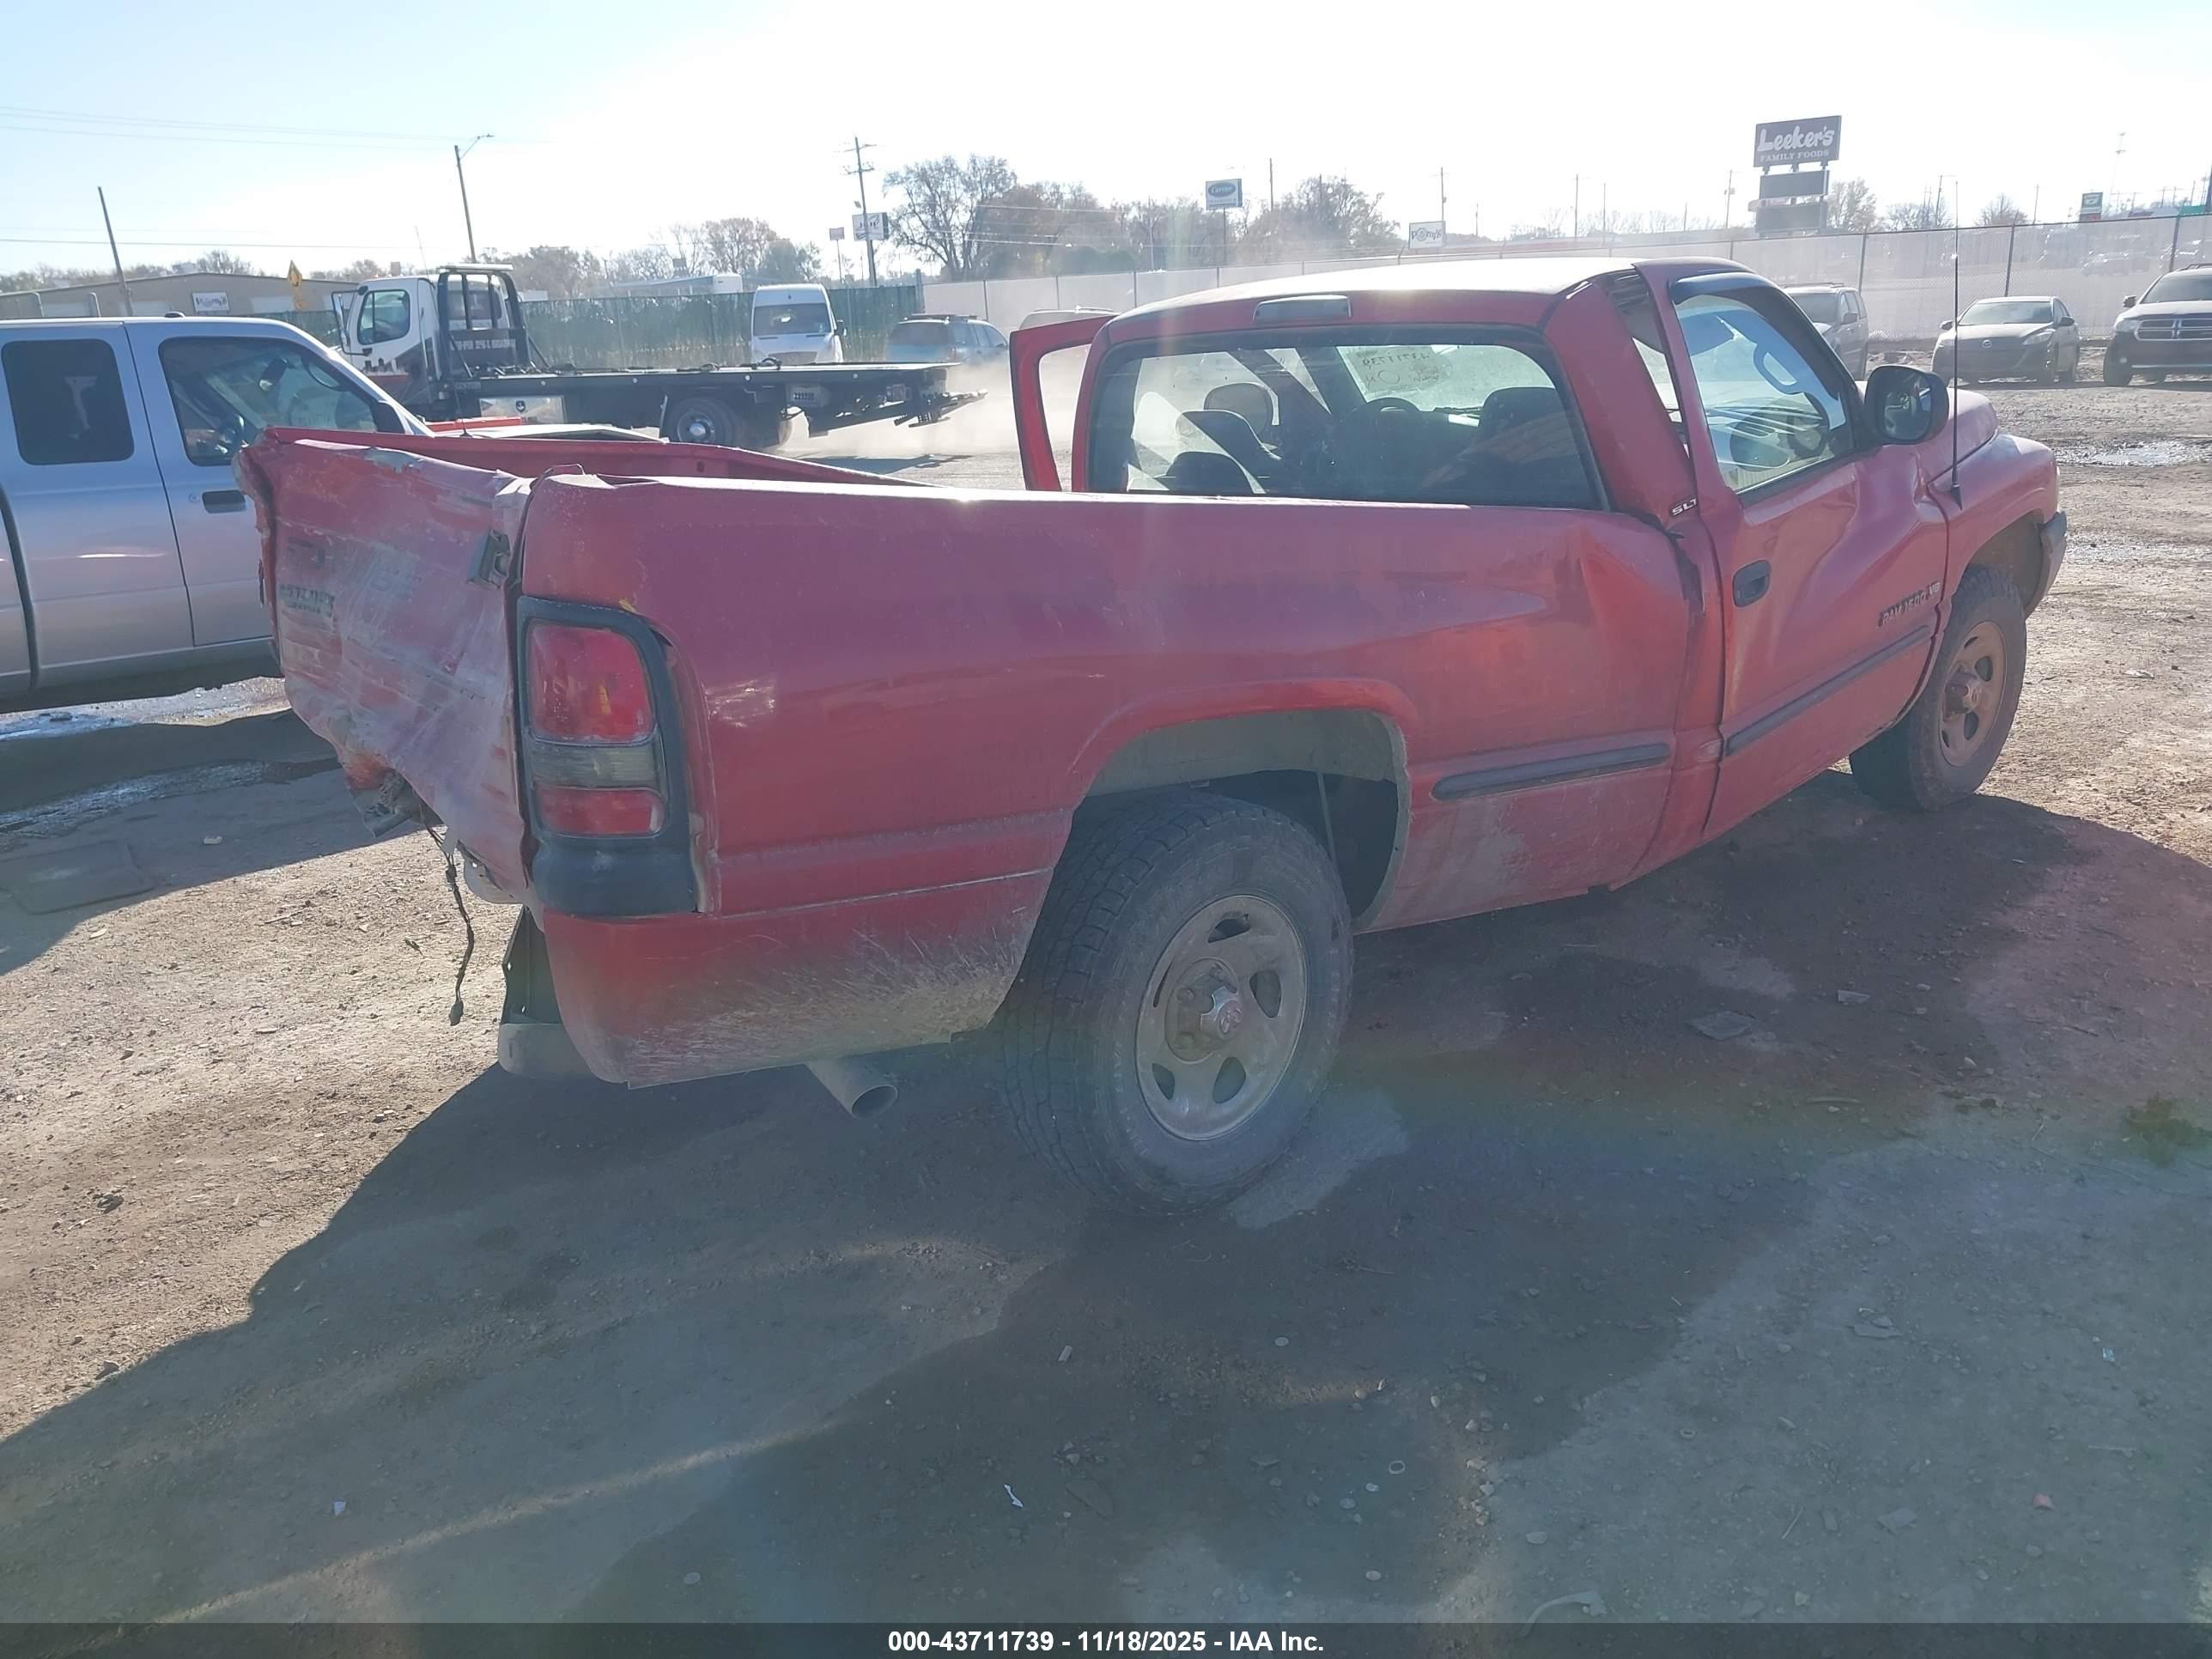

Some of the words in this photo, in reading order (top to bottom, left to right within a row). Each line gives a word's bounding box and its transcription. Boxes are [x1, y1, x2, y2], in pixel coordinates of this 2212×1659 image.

[1757, 125, 1834, 151] Leeker's
[1759, 153, 1795, 162] FAMILY
[1798, 149, 1829, 159] FOODS
[1672, 499, 1697, 516] SLT
[1880, 605, 1903, 626] RAM
